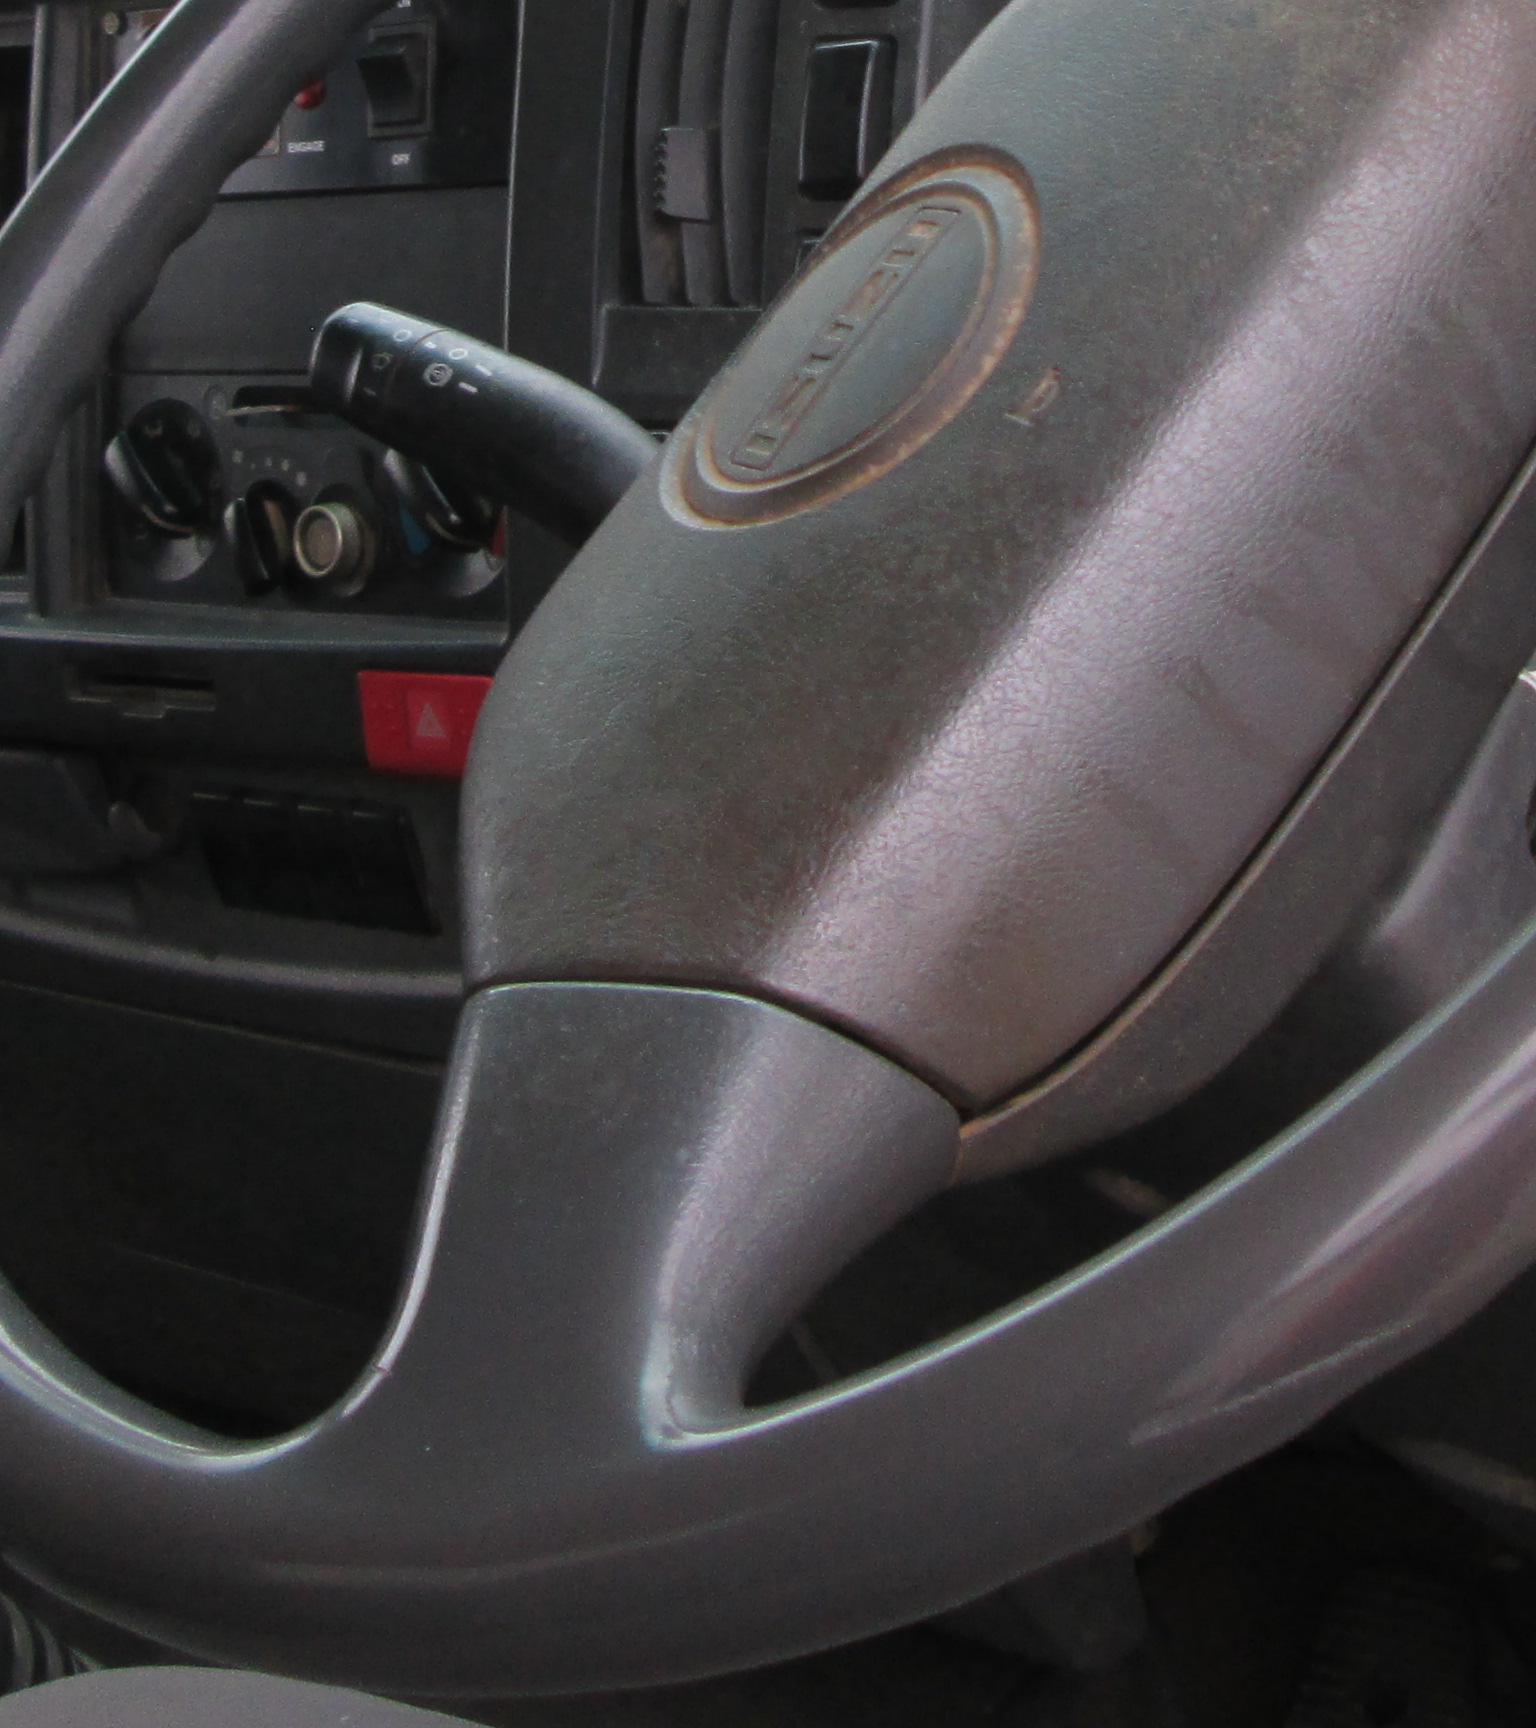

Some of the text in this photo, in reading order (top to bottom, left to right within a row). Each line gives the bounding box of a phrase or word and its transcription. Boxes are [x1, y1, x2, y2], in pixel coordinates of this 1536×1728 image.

[287, 140, 326, 153] ENGAGE
[391, 153, 411, 166] OFF
[730, 206, 963, 472] ISUZU
